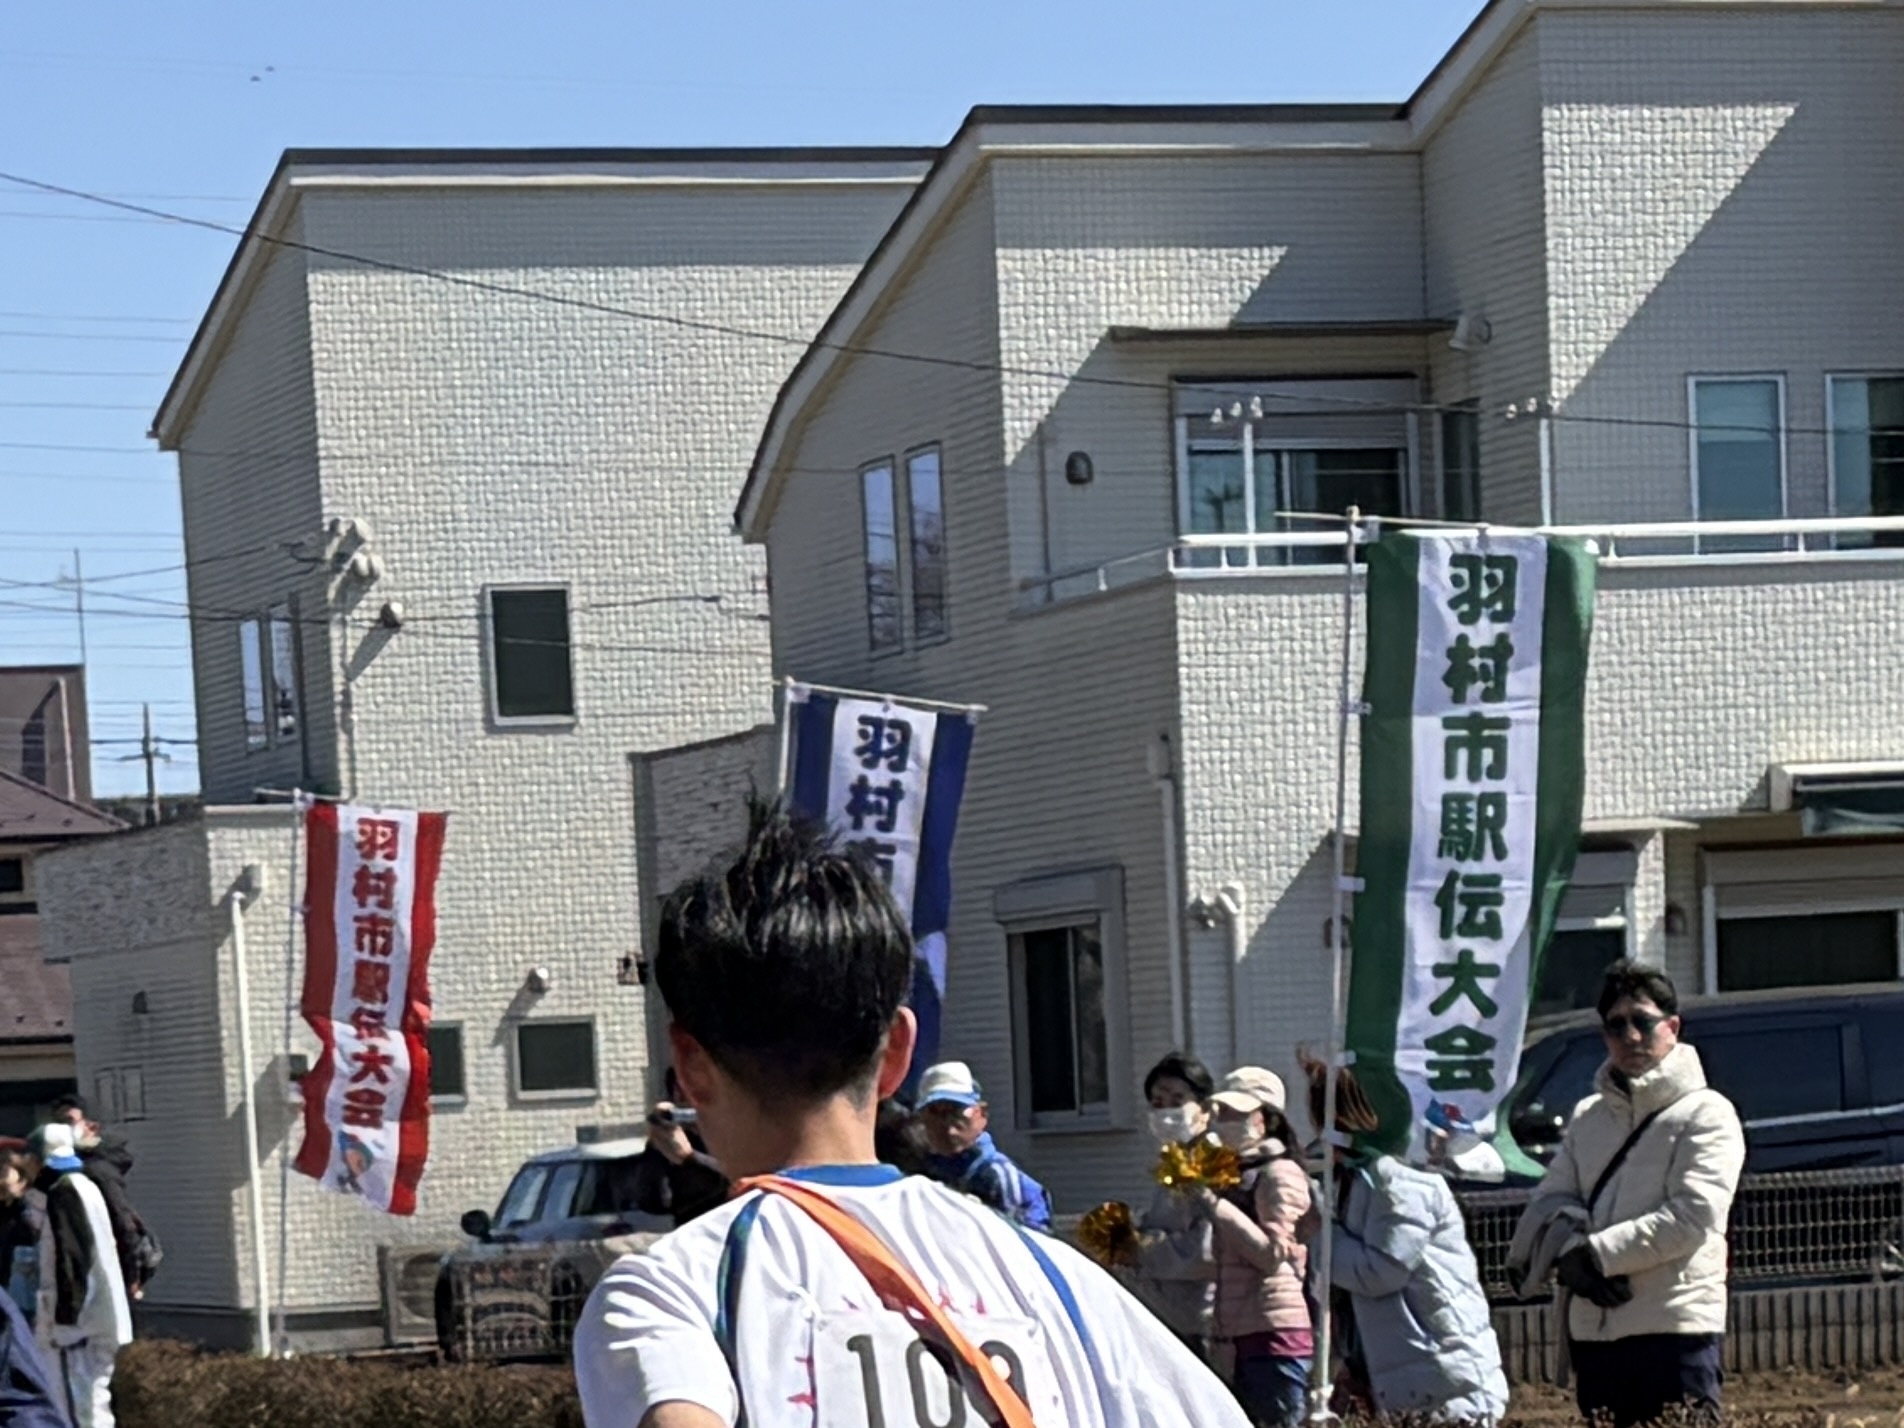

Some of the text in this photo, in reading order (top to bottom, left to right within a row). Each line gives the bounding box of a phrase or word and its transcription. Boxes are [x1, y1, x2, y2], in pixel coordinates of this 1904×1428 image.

[342, 817, 400, 1129] 羽村市駅伝大会
[1423, 552, 1520, 1093] 羽村市駅伝大会
